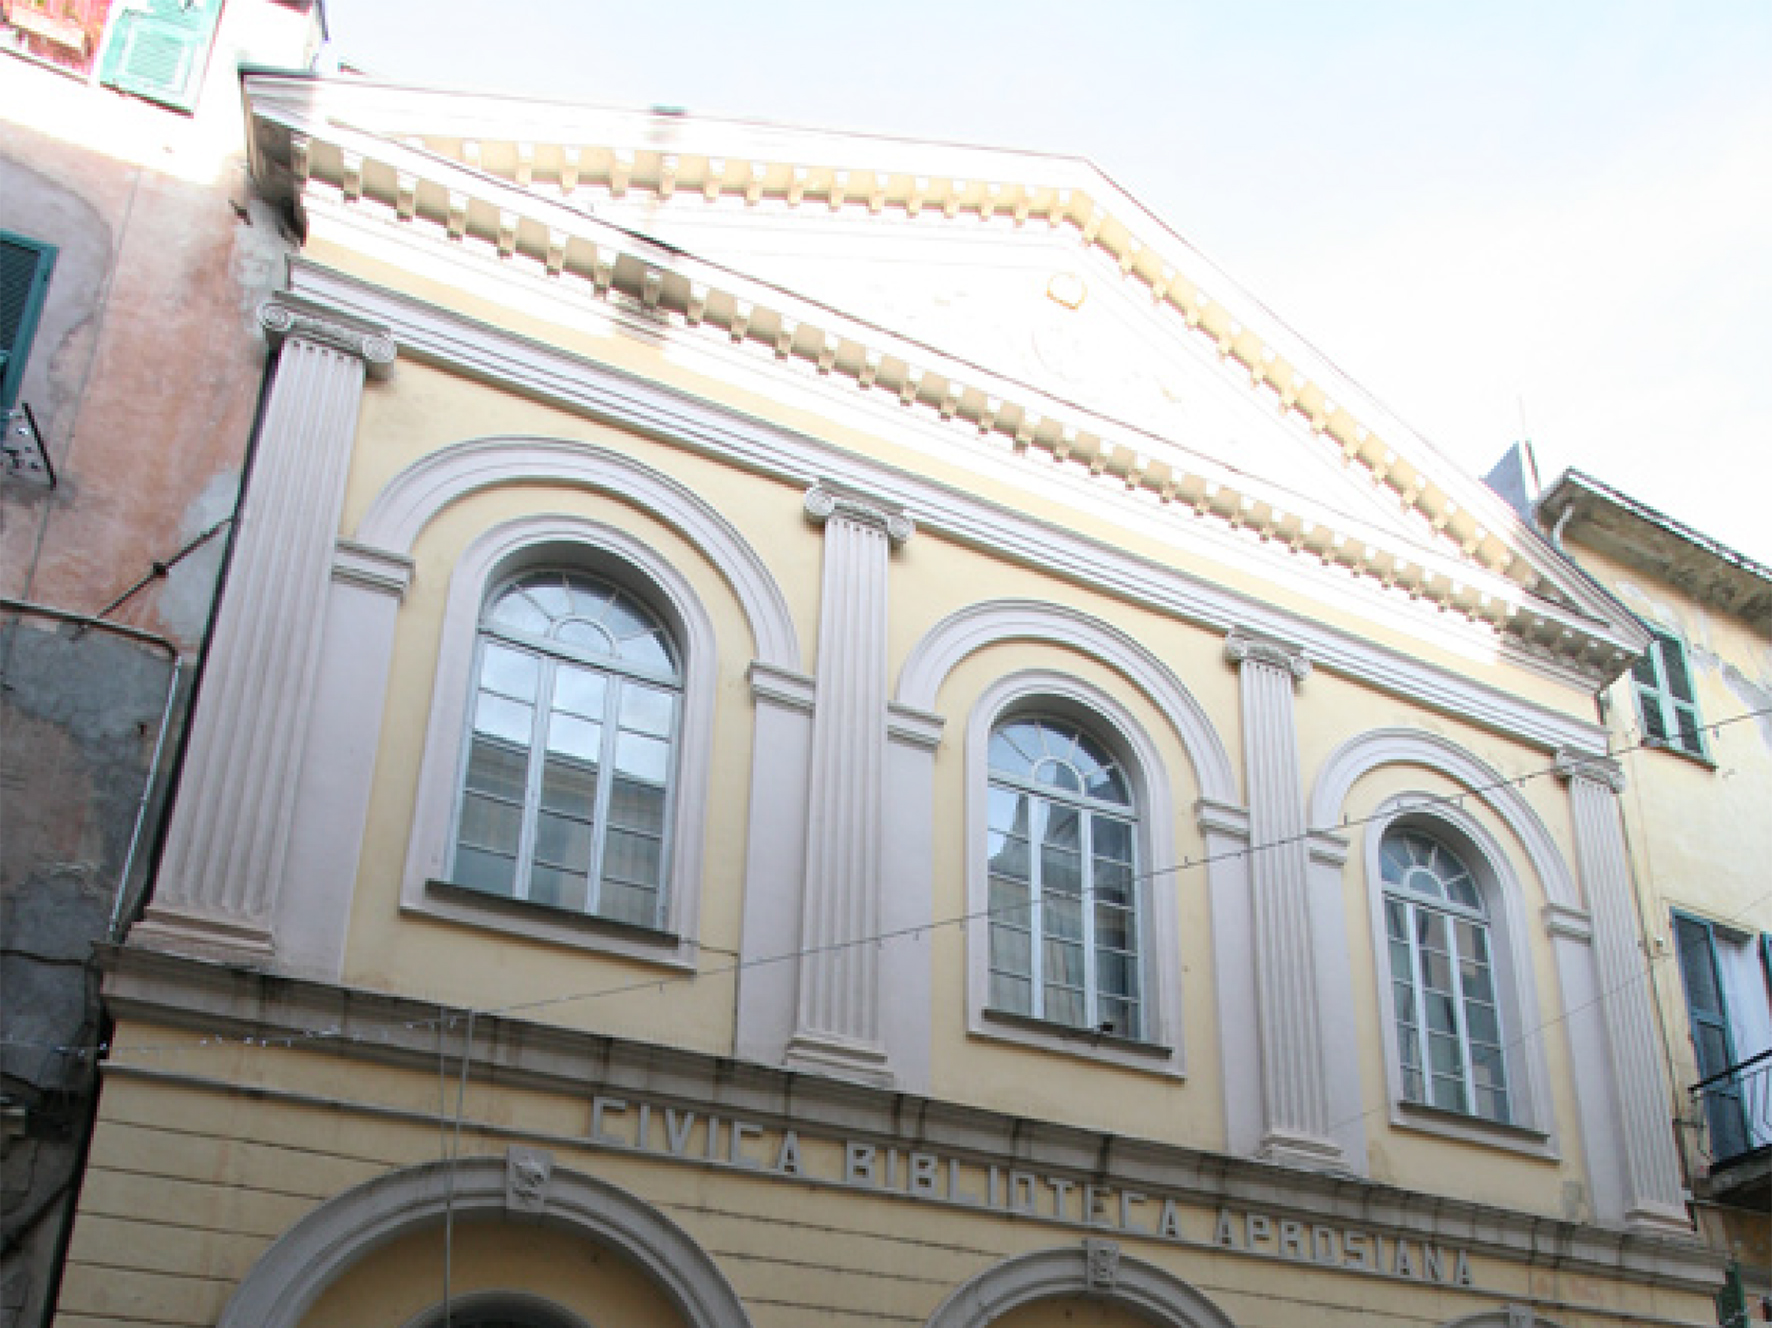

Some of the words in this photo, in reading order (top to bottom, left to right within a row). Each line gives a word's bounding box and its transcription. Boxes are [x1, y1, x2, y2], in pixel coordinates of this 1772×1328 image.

[592, 1096, 802, 1177] CIVICA
[844, 1141, 1182, 1238] BIBLIOTECA
[1214, 1209, 1474, 1286] APROSIANA
